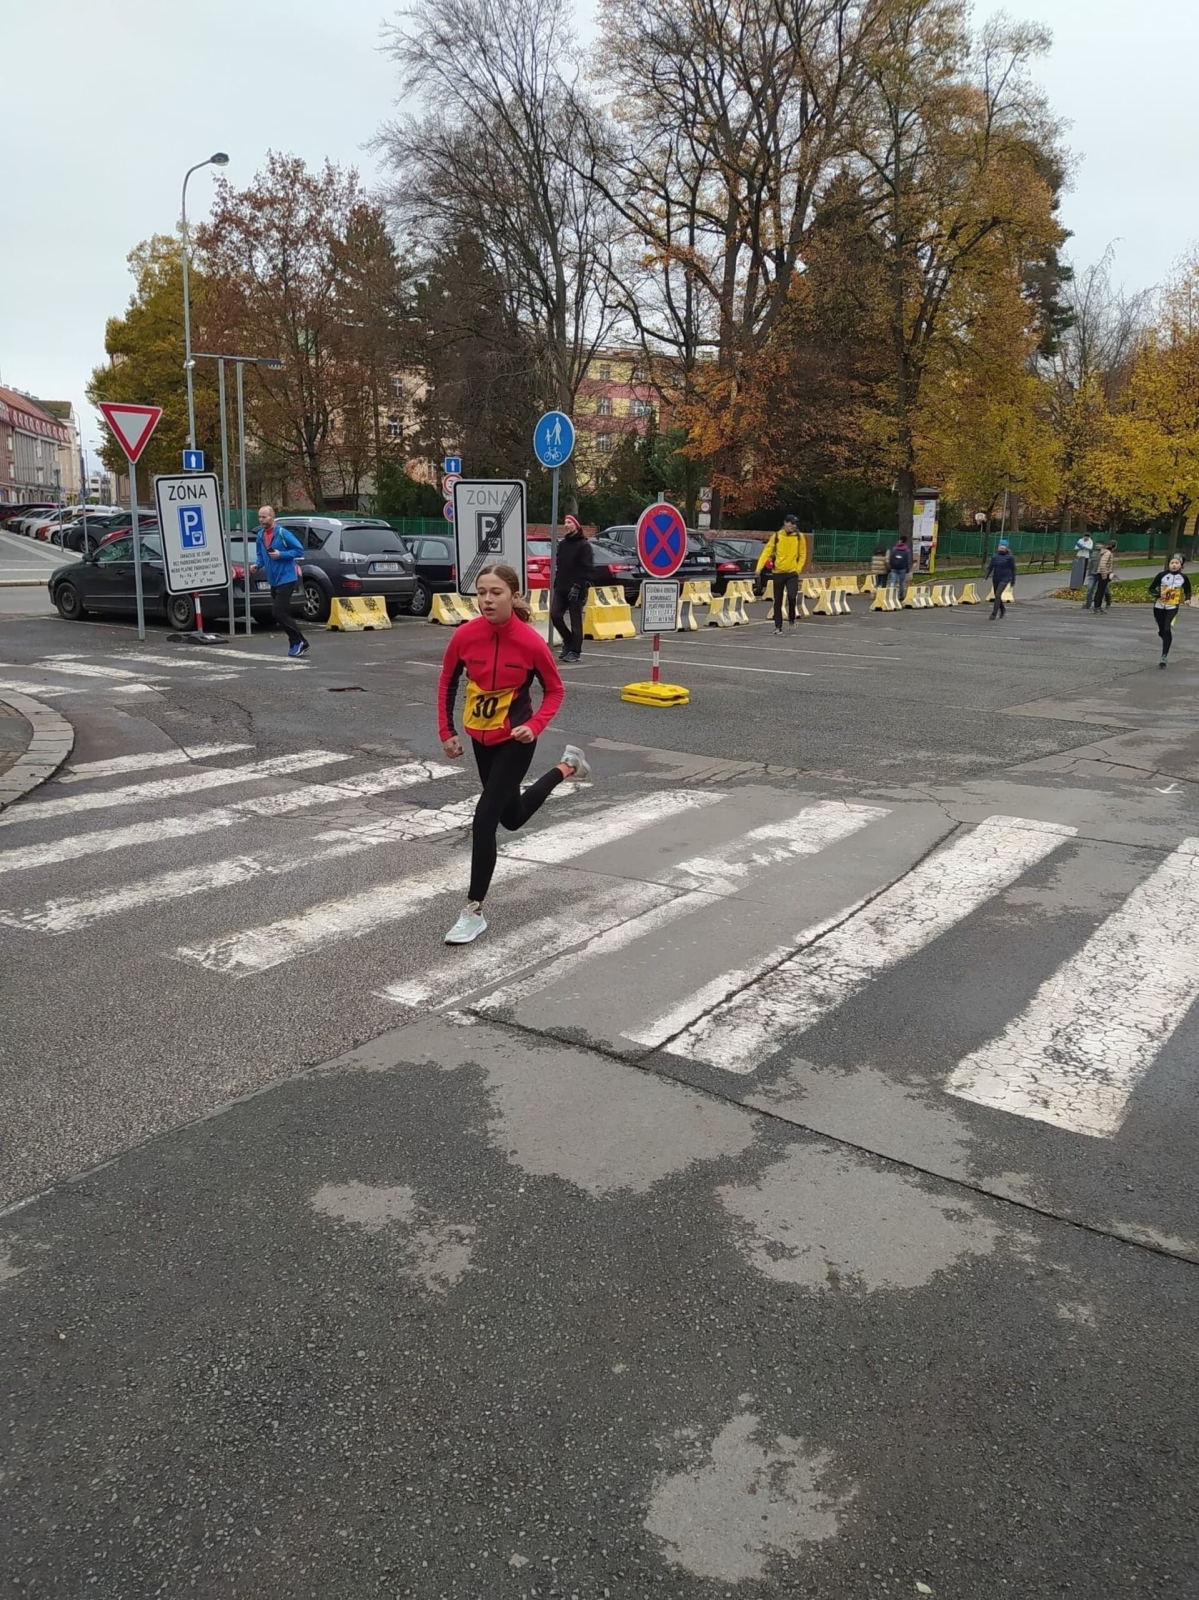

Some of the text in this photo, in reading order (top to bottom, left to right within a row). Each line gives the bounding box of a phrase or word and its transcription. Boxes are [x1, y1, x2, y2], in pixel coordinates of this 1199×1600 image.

[168, 481, 208, 501] ZÓNA
[466, 486, 511, 505] ZÓNA
[183, 511, 198, 536] P
[472, 695, 499, 719] 30
